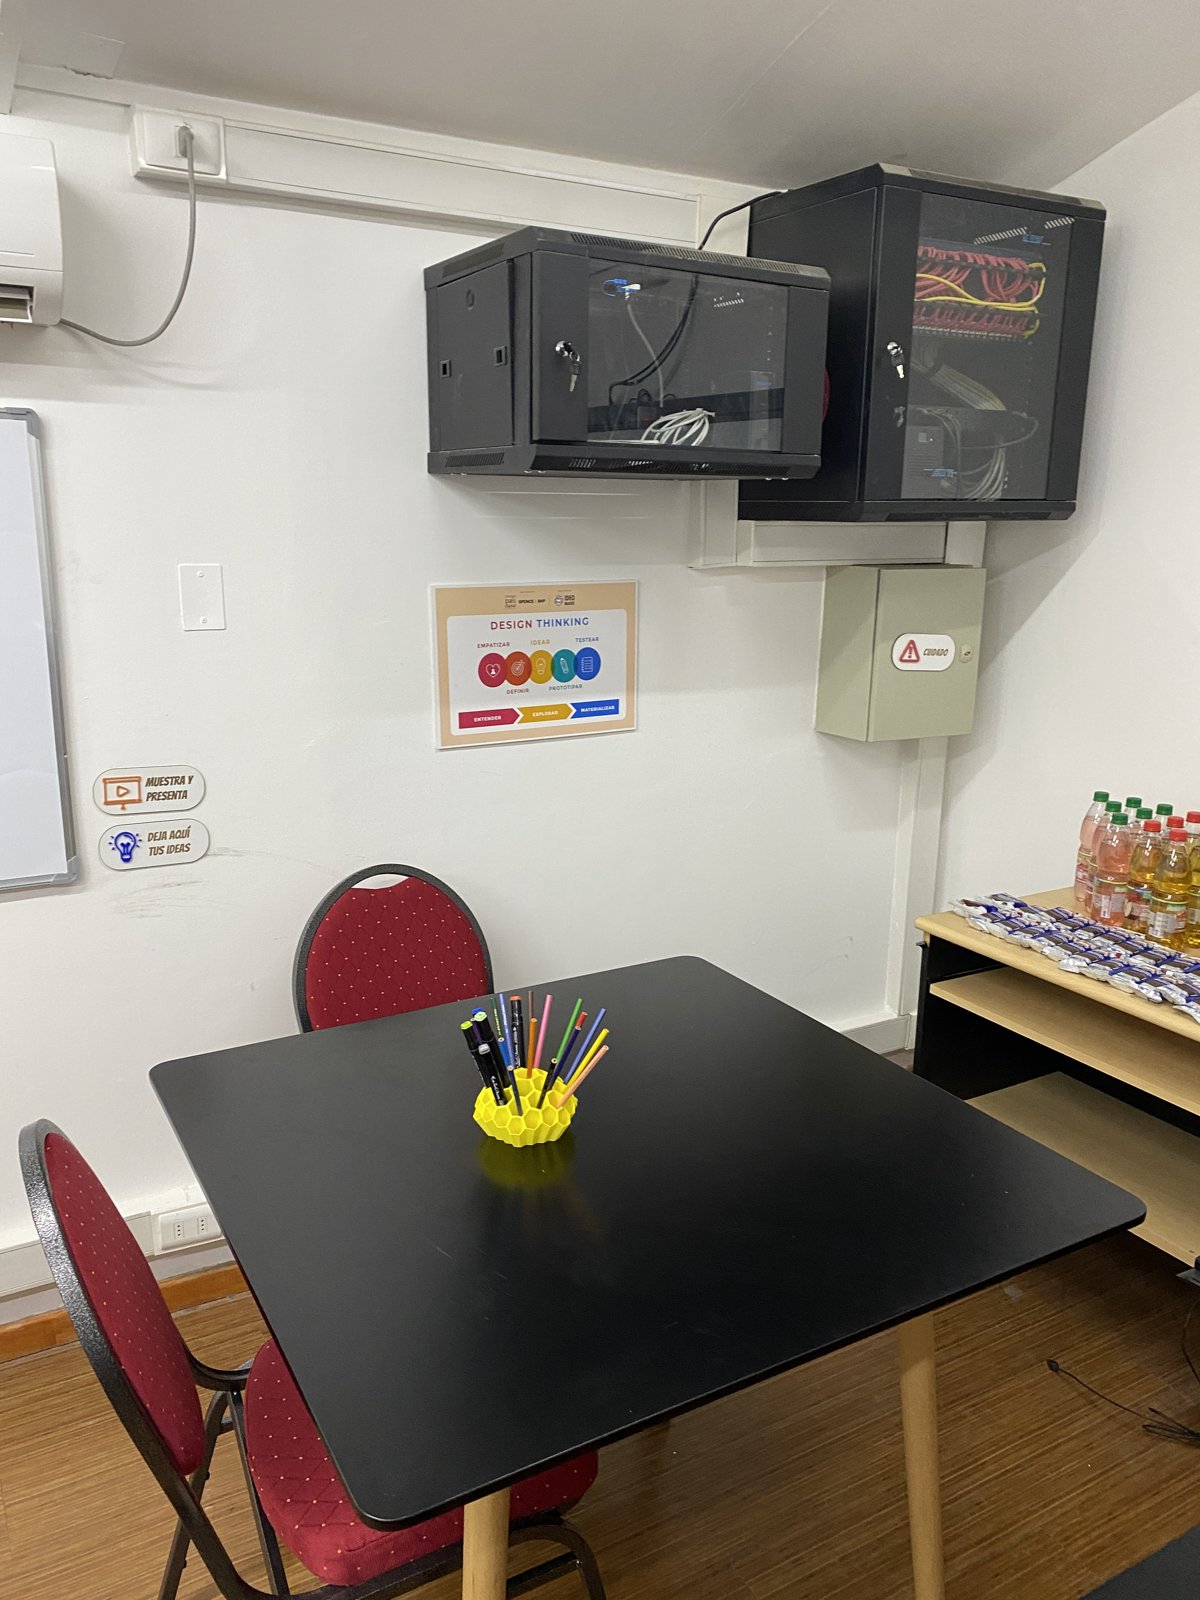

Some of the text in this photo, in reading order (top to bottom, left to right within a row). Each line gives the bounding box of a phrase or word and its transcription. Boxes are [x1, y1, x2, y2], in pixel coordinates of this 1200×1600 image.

[490, 617, 589, 630] DESIGN THINKING
[923, 648, 949, 657] CUIDADO
[580, 705, 615, 713] MATERIALIZAR
[473, 715, 502, 723] ENTENDER
[145, 775, 194, 787] MUESTRA Y
[145, 790, 188, 802] PRESENTA
[147, 825, 191, 842] DEJA AQUÍ
[148, 843, 191, 856] TUS IDEAS
